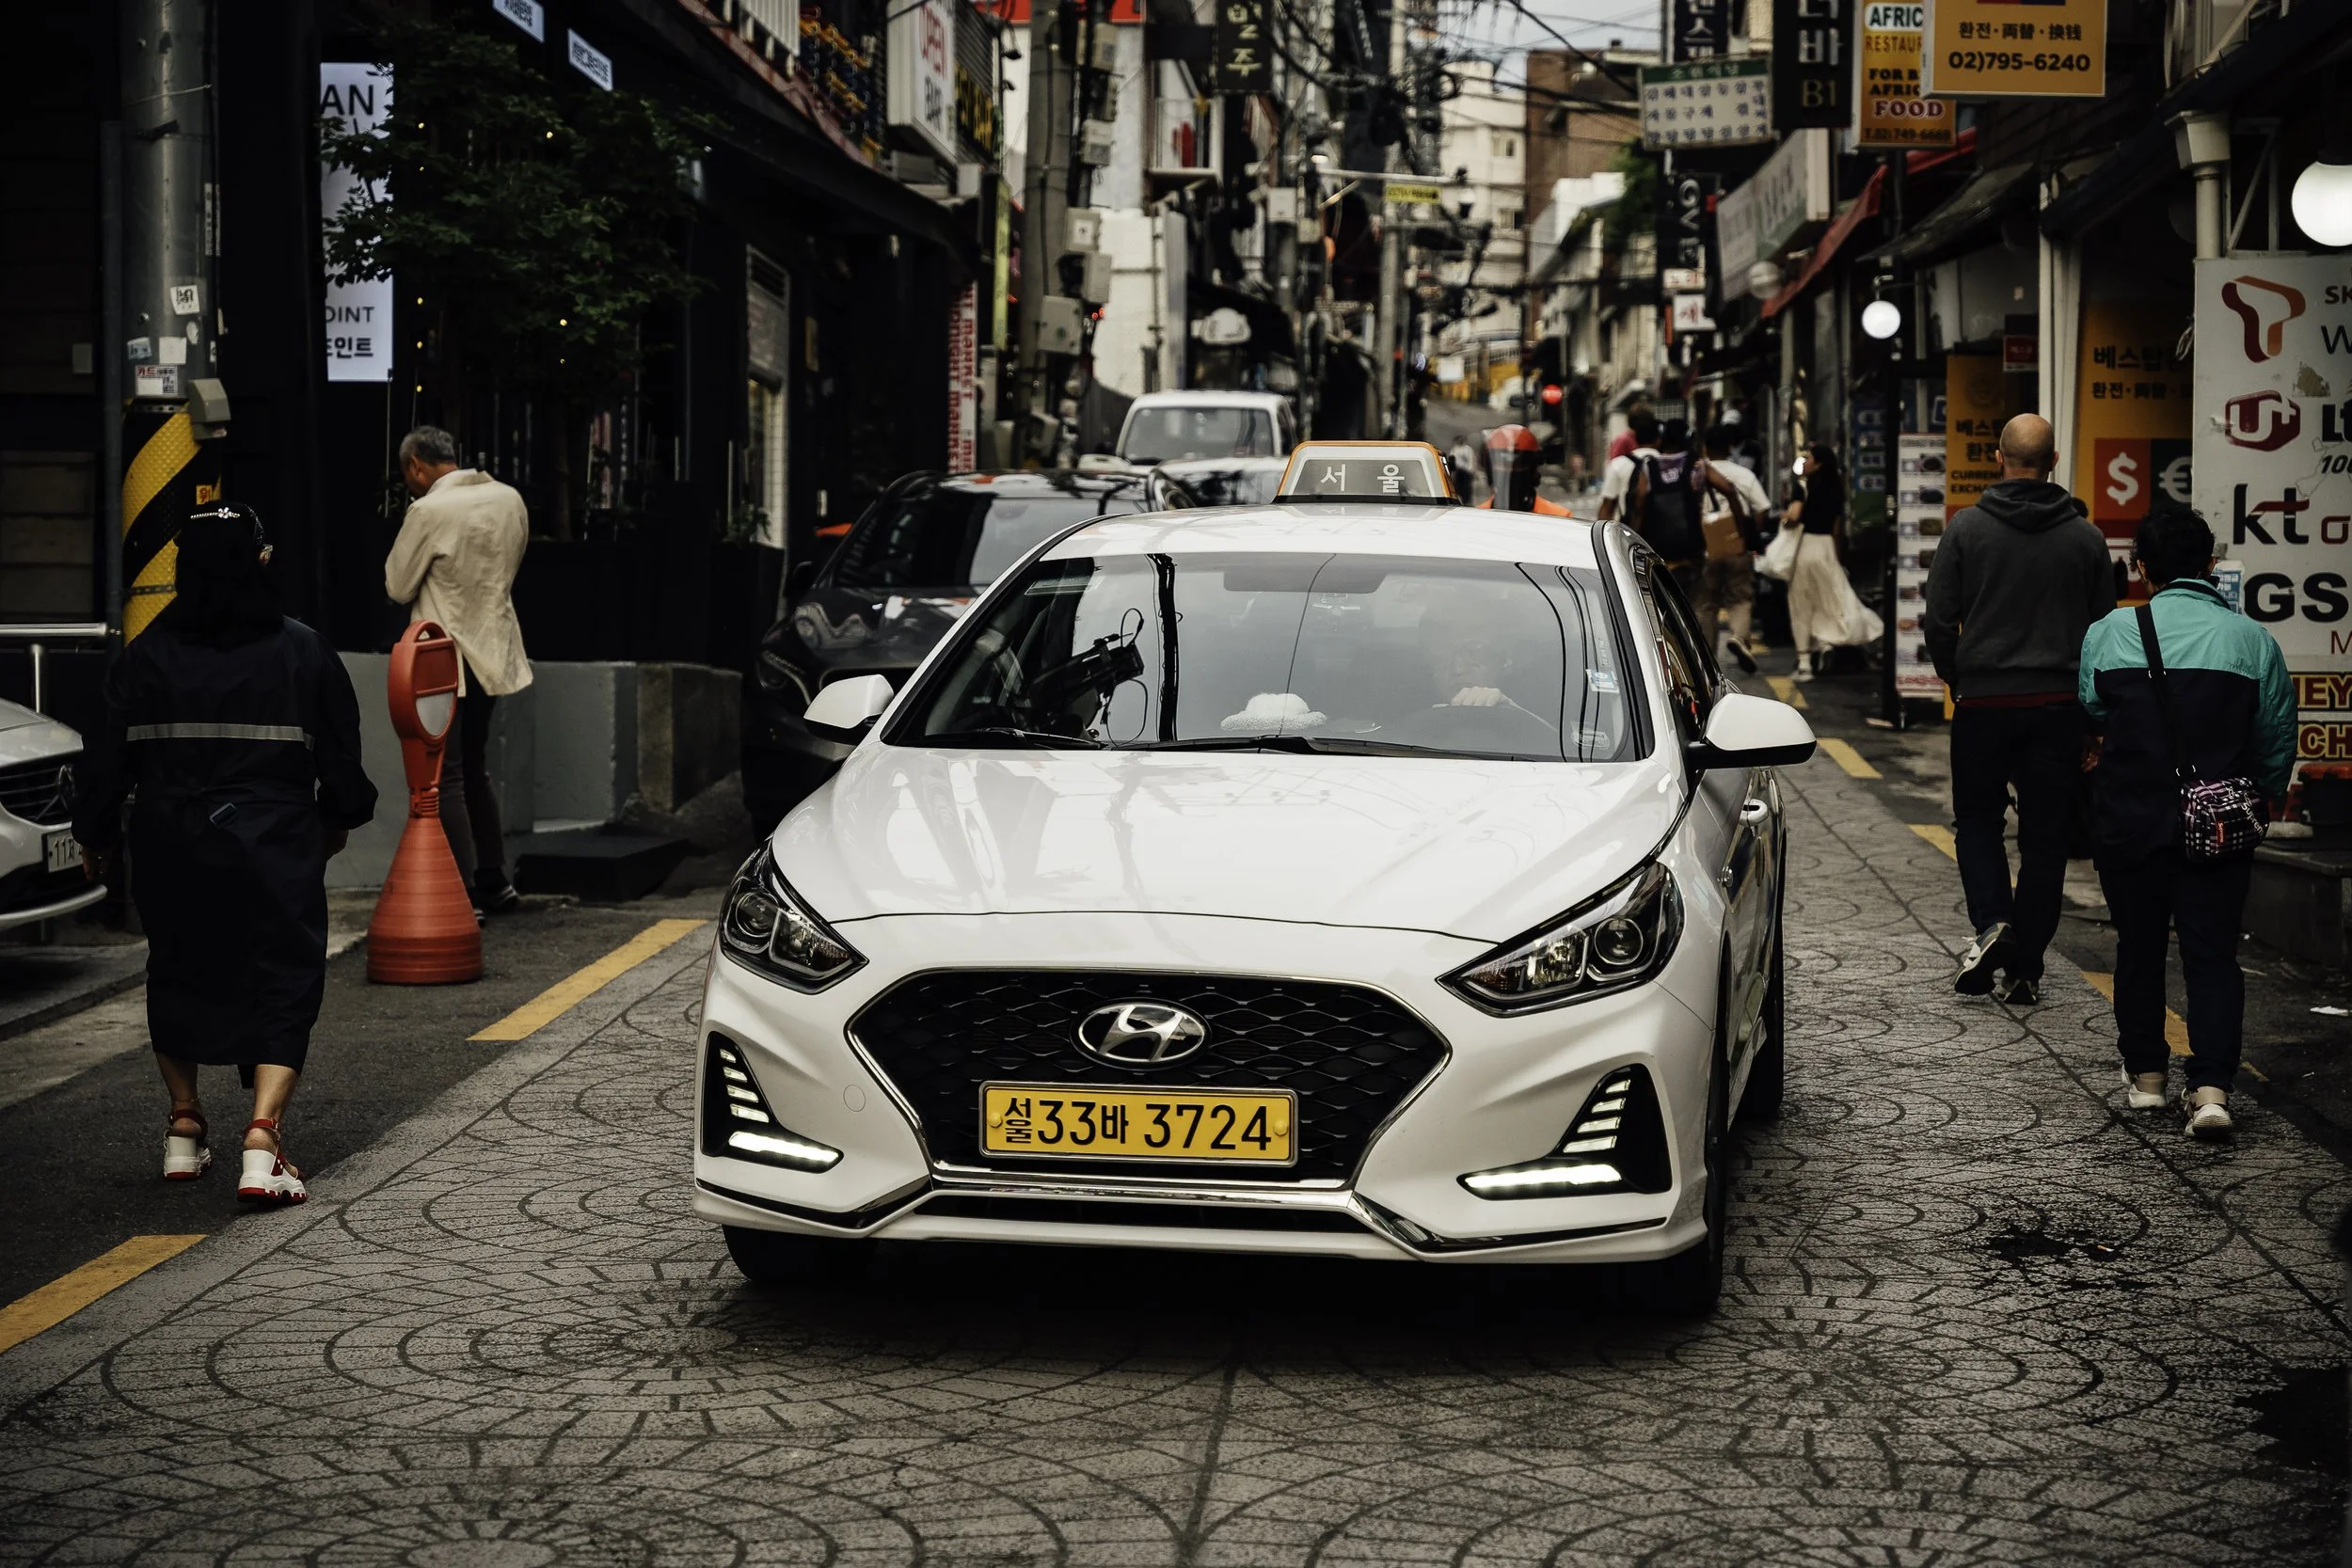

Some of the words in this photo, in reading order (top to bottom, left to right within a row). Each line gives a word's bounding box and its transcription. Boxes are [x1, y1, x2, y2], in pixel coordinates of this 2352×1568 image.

[1868, 69, 1902, 80] FOR
[1948, 51, 2090, 72] 02)795-6240
[1802, 79, 1836, 109] B1
[1873, 100, 1945, 118] FOOD
[2233, 483, 2310, 545] kt
[2244, 572, 2349, 623] GS
[1143, 1102, 1272, 1151] 3724
